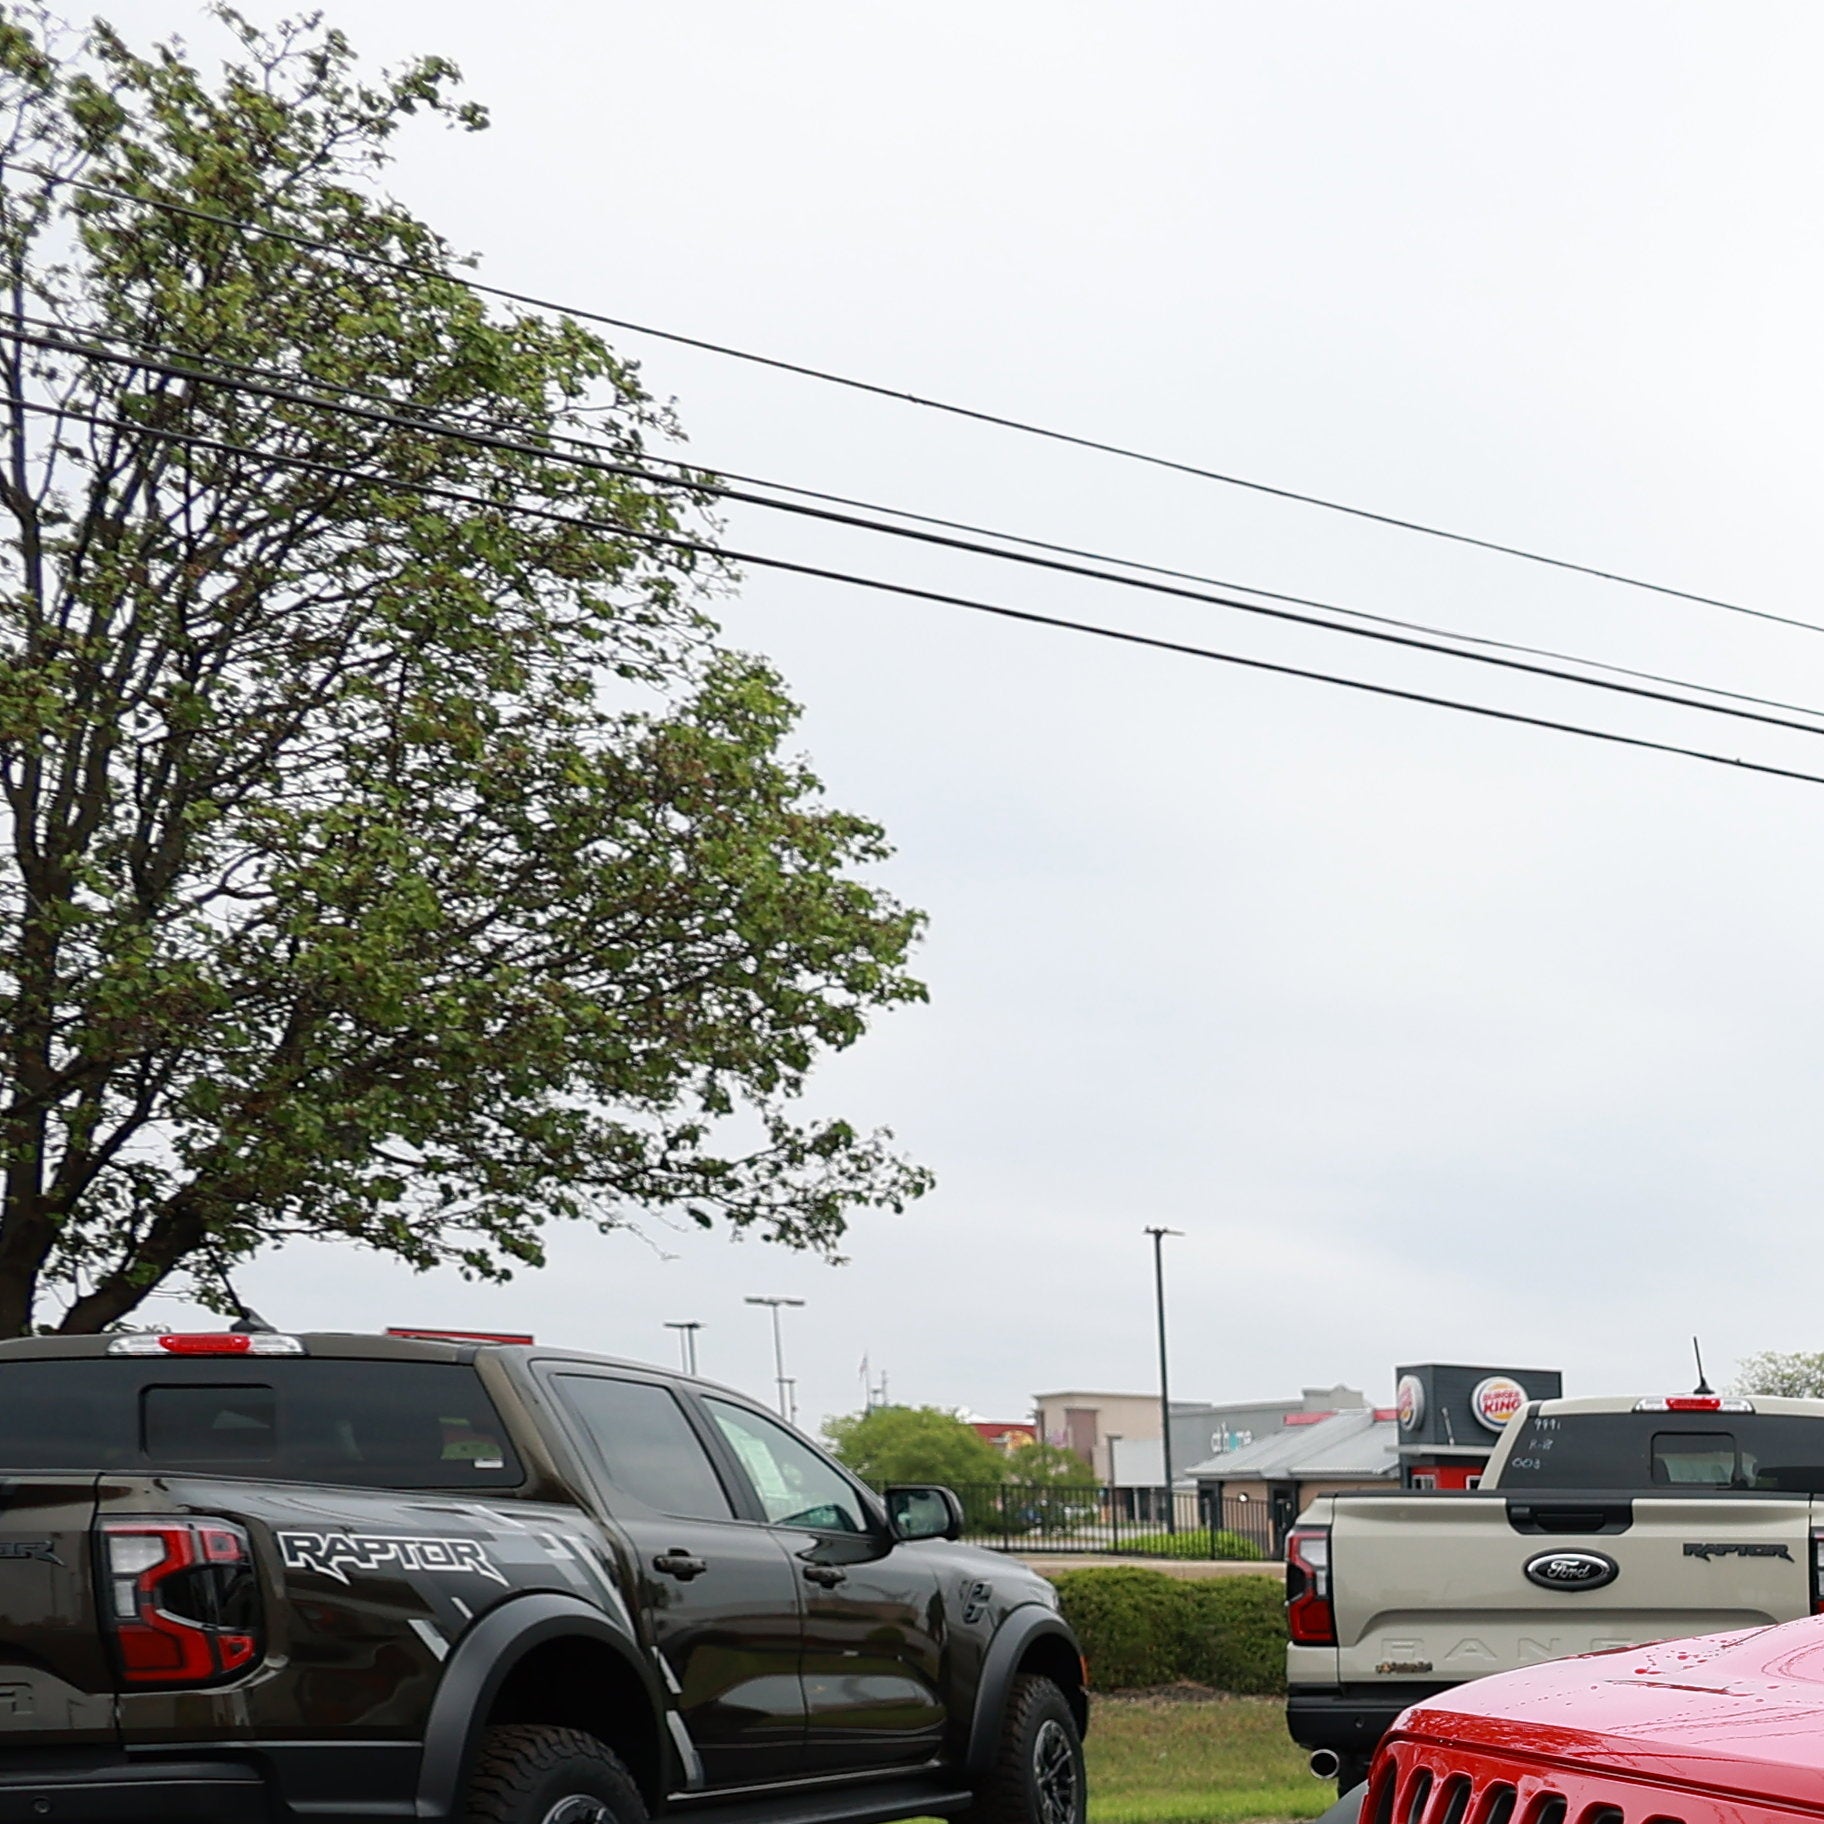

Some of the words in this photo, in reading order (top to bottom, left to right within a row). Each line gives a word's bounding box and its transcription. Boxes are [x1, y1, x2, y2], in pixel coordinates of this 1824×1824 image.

[1482, 1392, 1520, 1401] BURGER
[1483, 1401, 1521, 1414] KING
[275, 1530, 511, 1587] RAPTOR
[1683, 1543, 1795, 1563] RAPTOR
[1546, 1560, 1591, 1579] Ford
